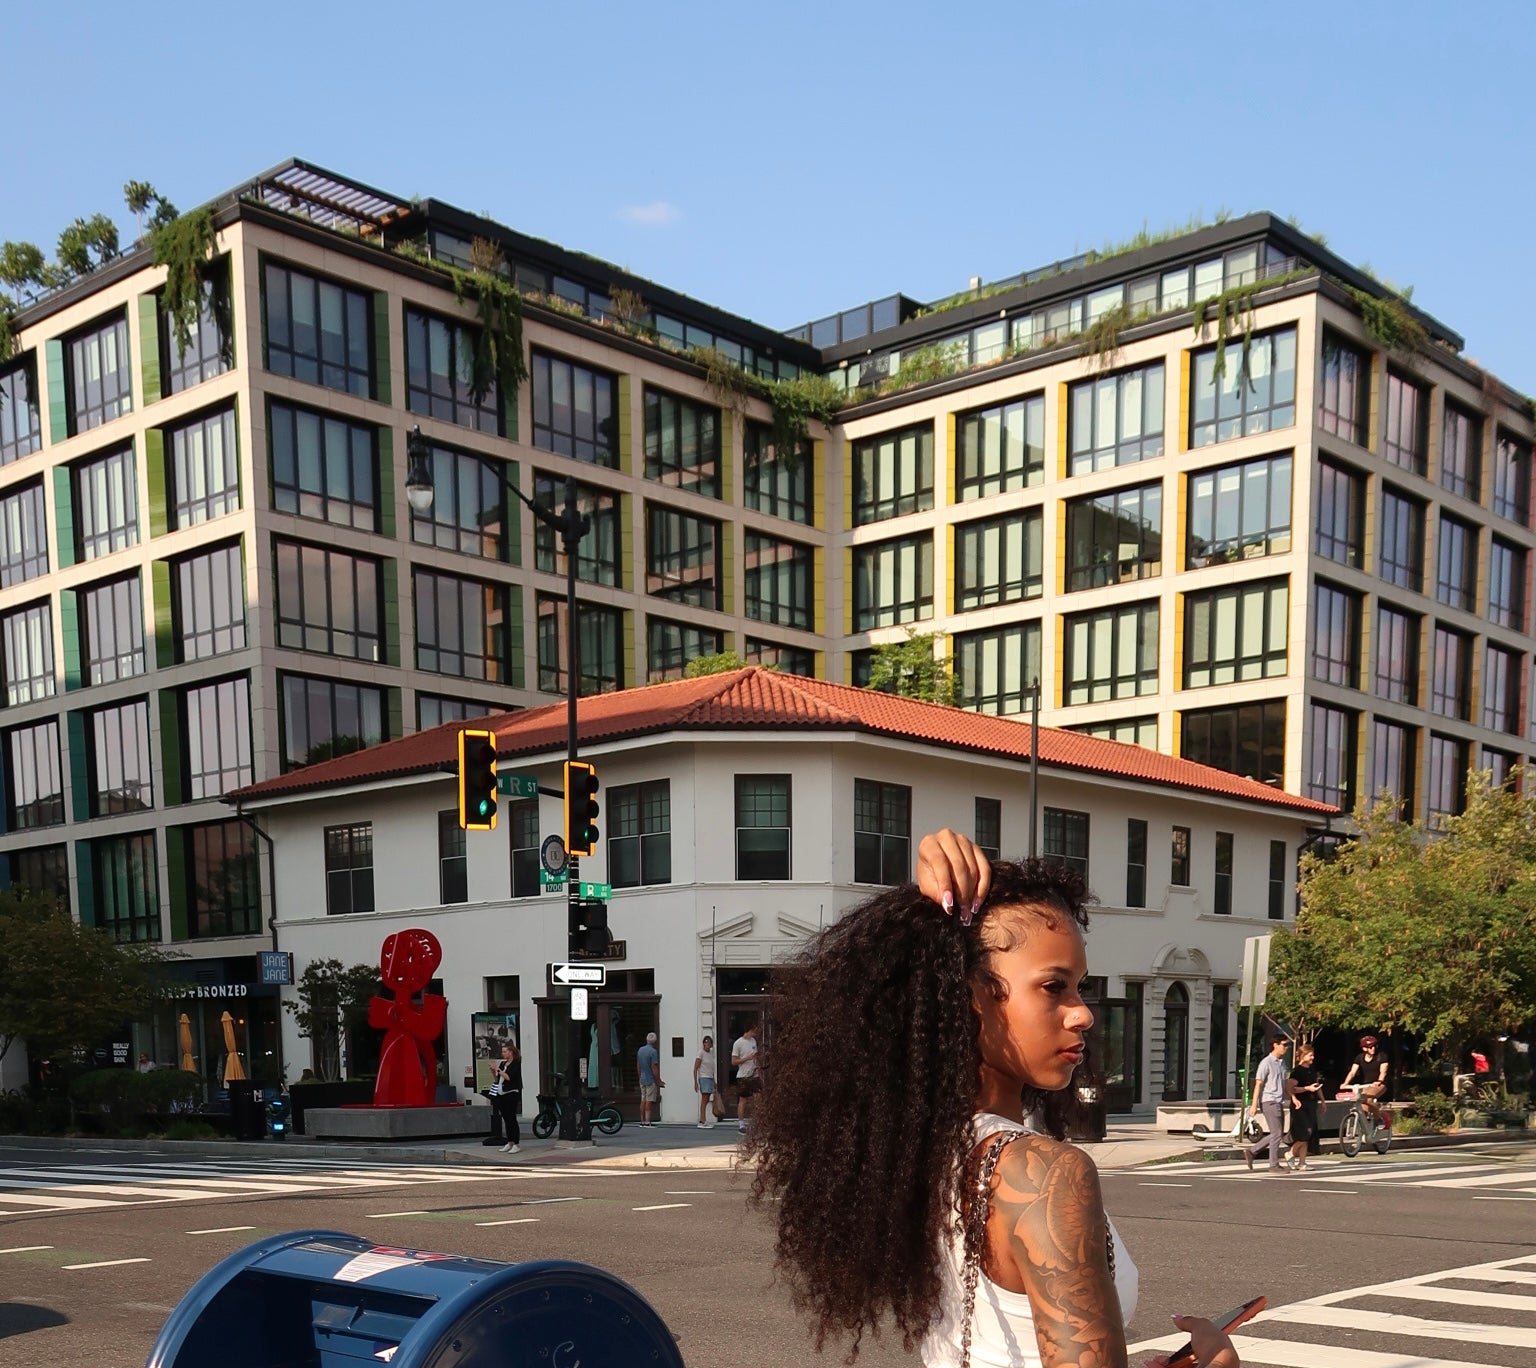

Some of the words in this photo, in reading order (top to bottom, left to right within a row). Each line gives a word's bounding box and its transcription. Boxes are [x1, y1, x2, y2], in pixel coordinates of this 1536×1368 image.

[510, 777, 521, 794] R
[527, 782, 537, 793] ST
[547, 883, 562, 892] 1700
[587, 884, 595, 897] R
[263, 956, 287, 967] JANE
[264, 969, 287, 981] JANE
[567, 970, 582, 979] ONE
[584, 971, 599, 979] WAY
[197, 984, 247, 998] BRONZED
